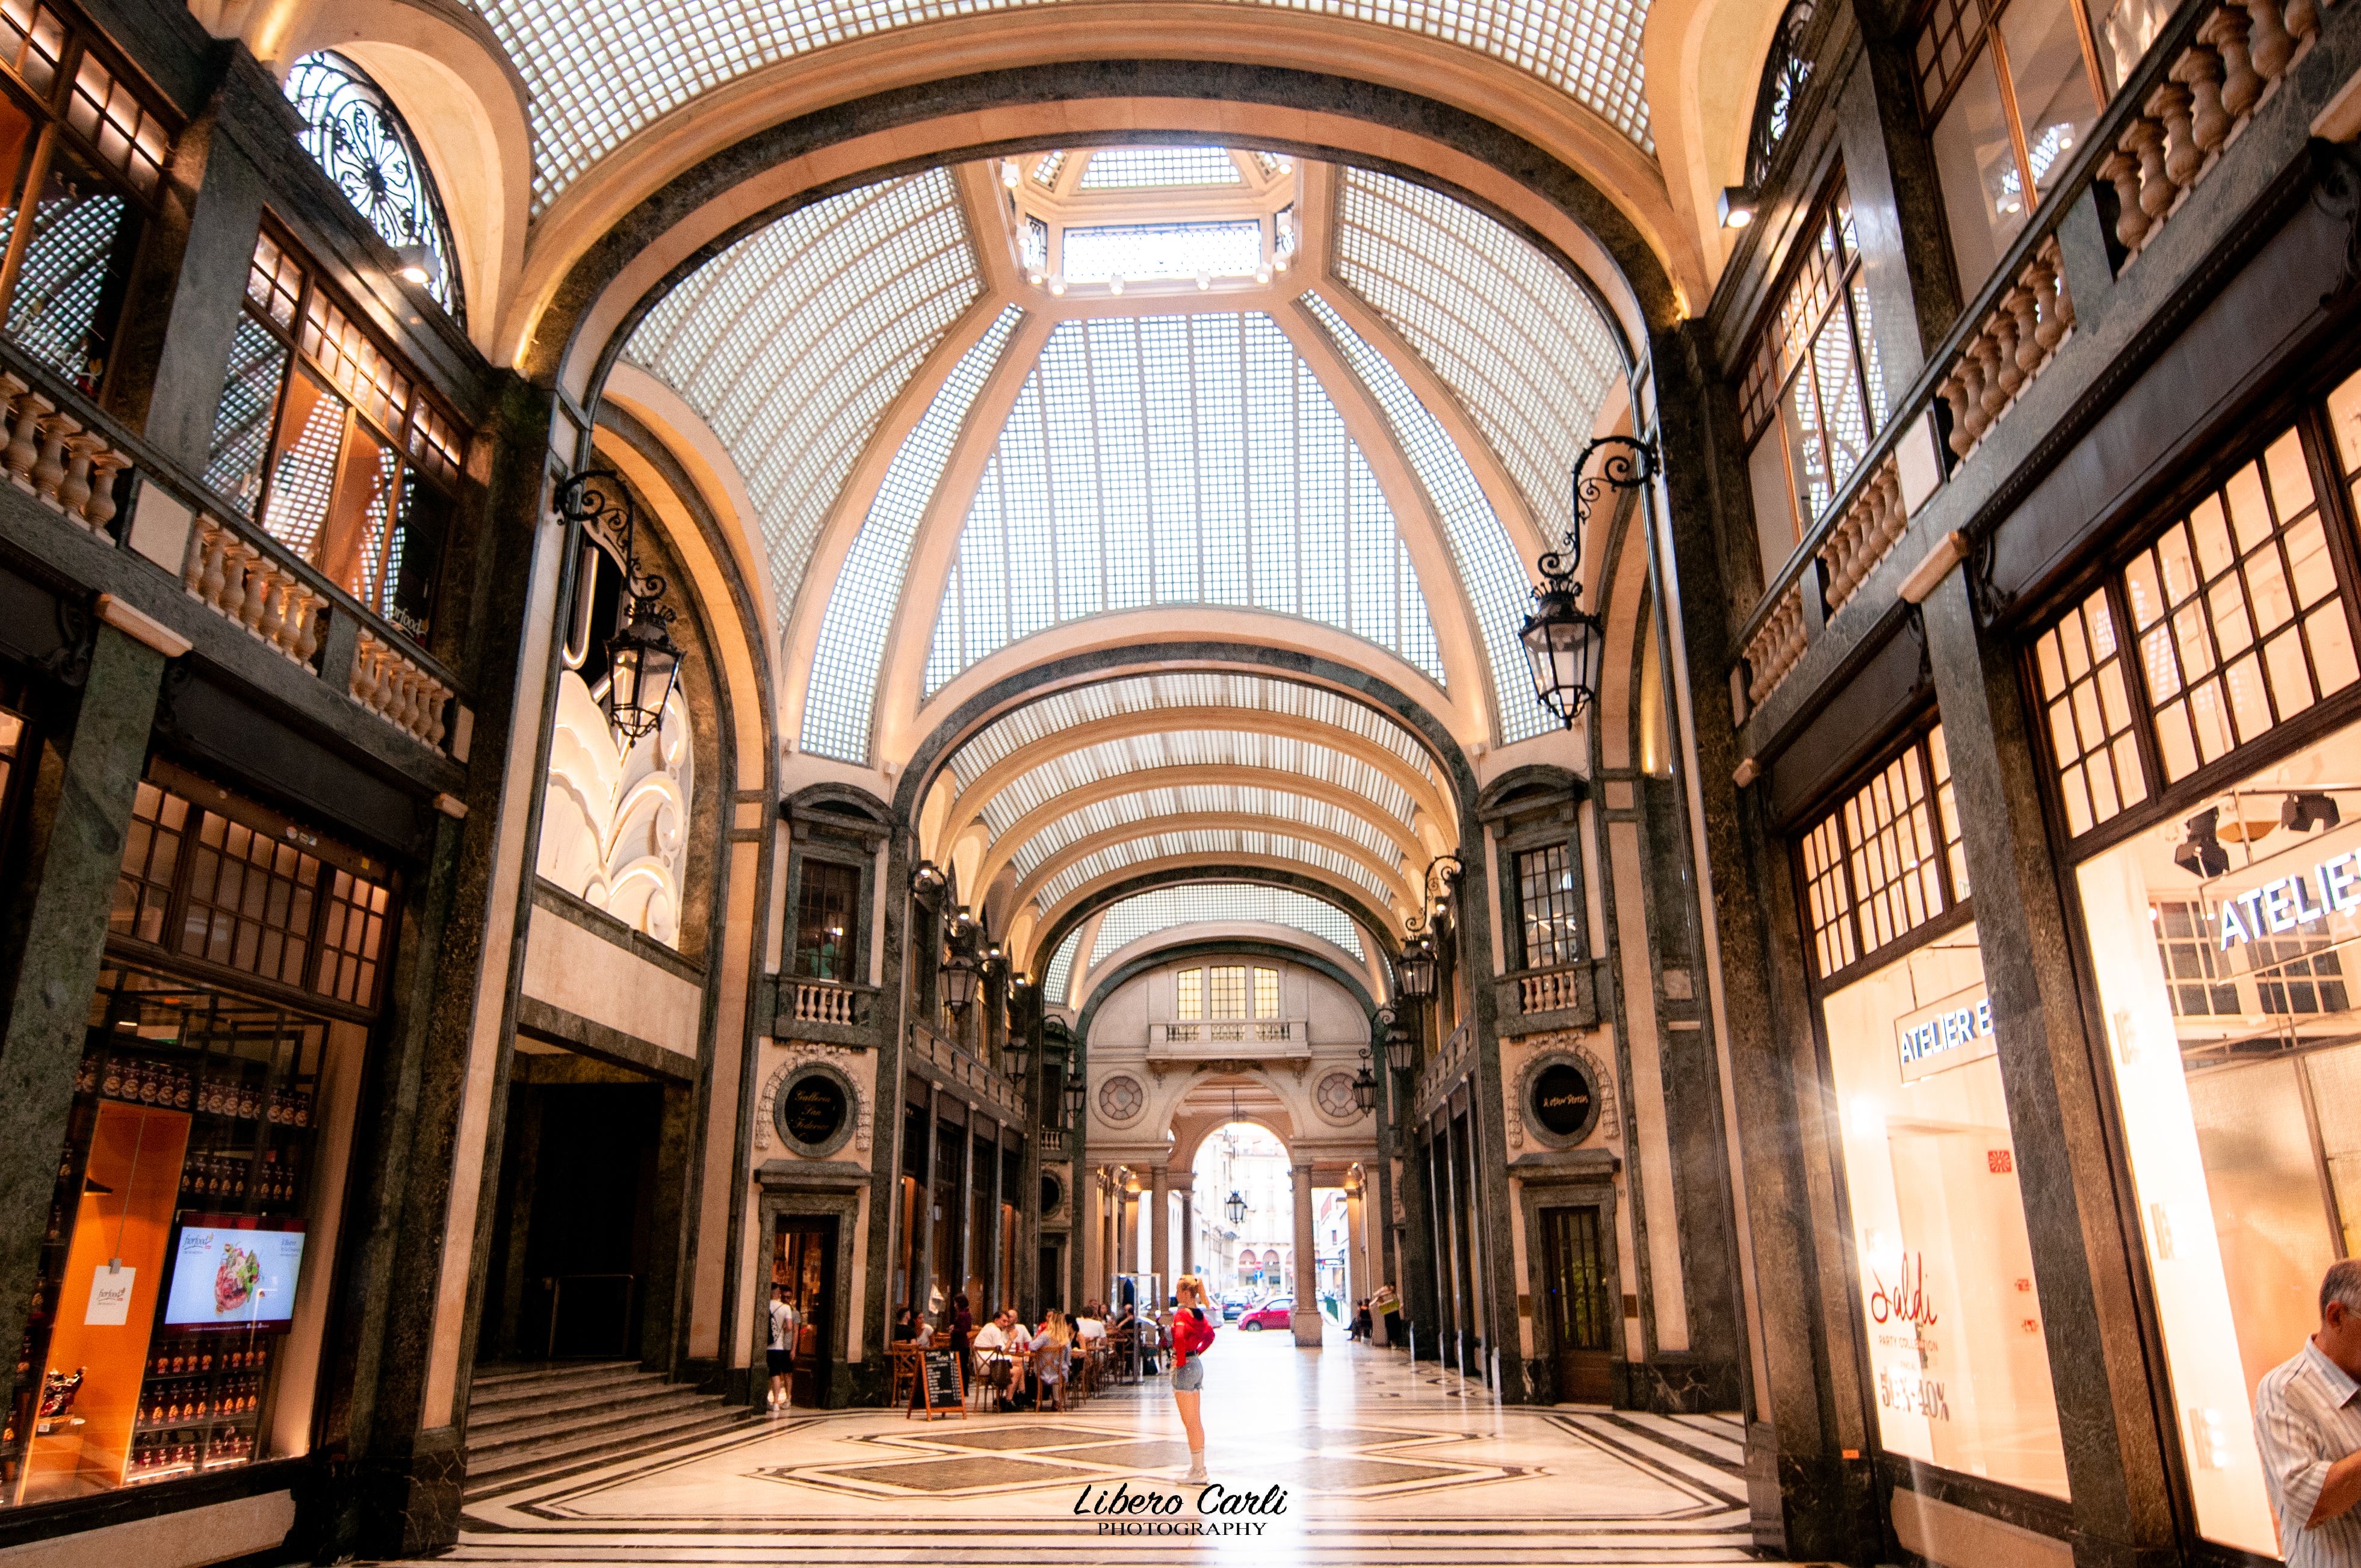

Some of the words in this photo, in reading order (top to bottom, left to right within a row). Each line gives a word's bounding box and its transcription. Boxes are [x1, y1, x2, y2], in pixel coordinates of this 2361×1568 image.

[2220, 847, 2361, 951] ATELIE
[1901, 1007, 1977, 1066] ATELIER
[1871, 1251, 1938, 1326] Saldi
[1878, 1334, 1897, 1348] PARTY
[1898, 1336, 1939, 1353] COLLECTION
